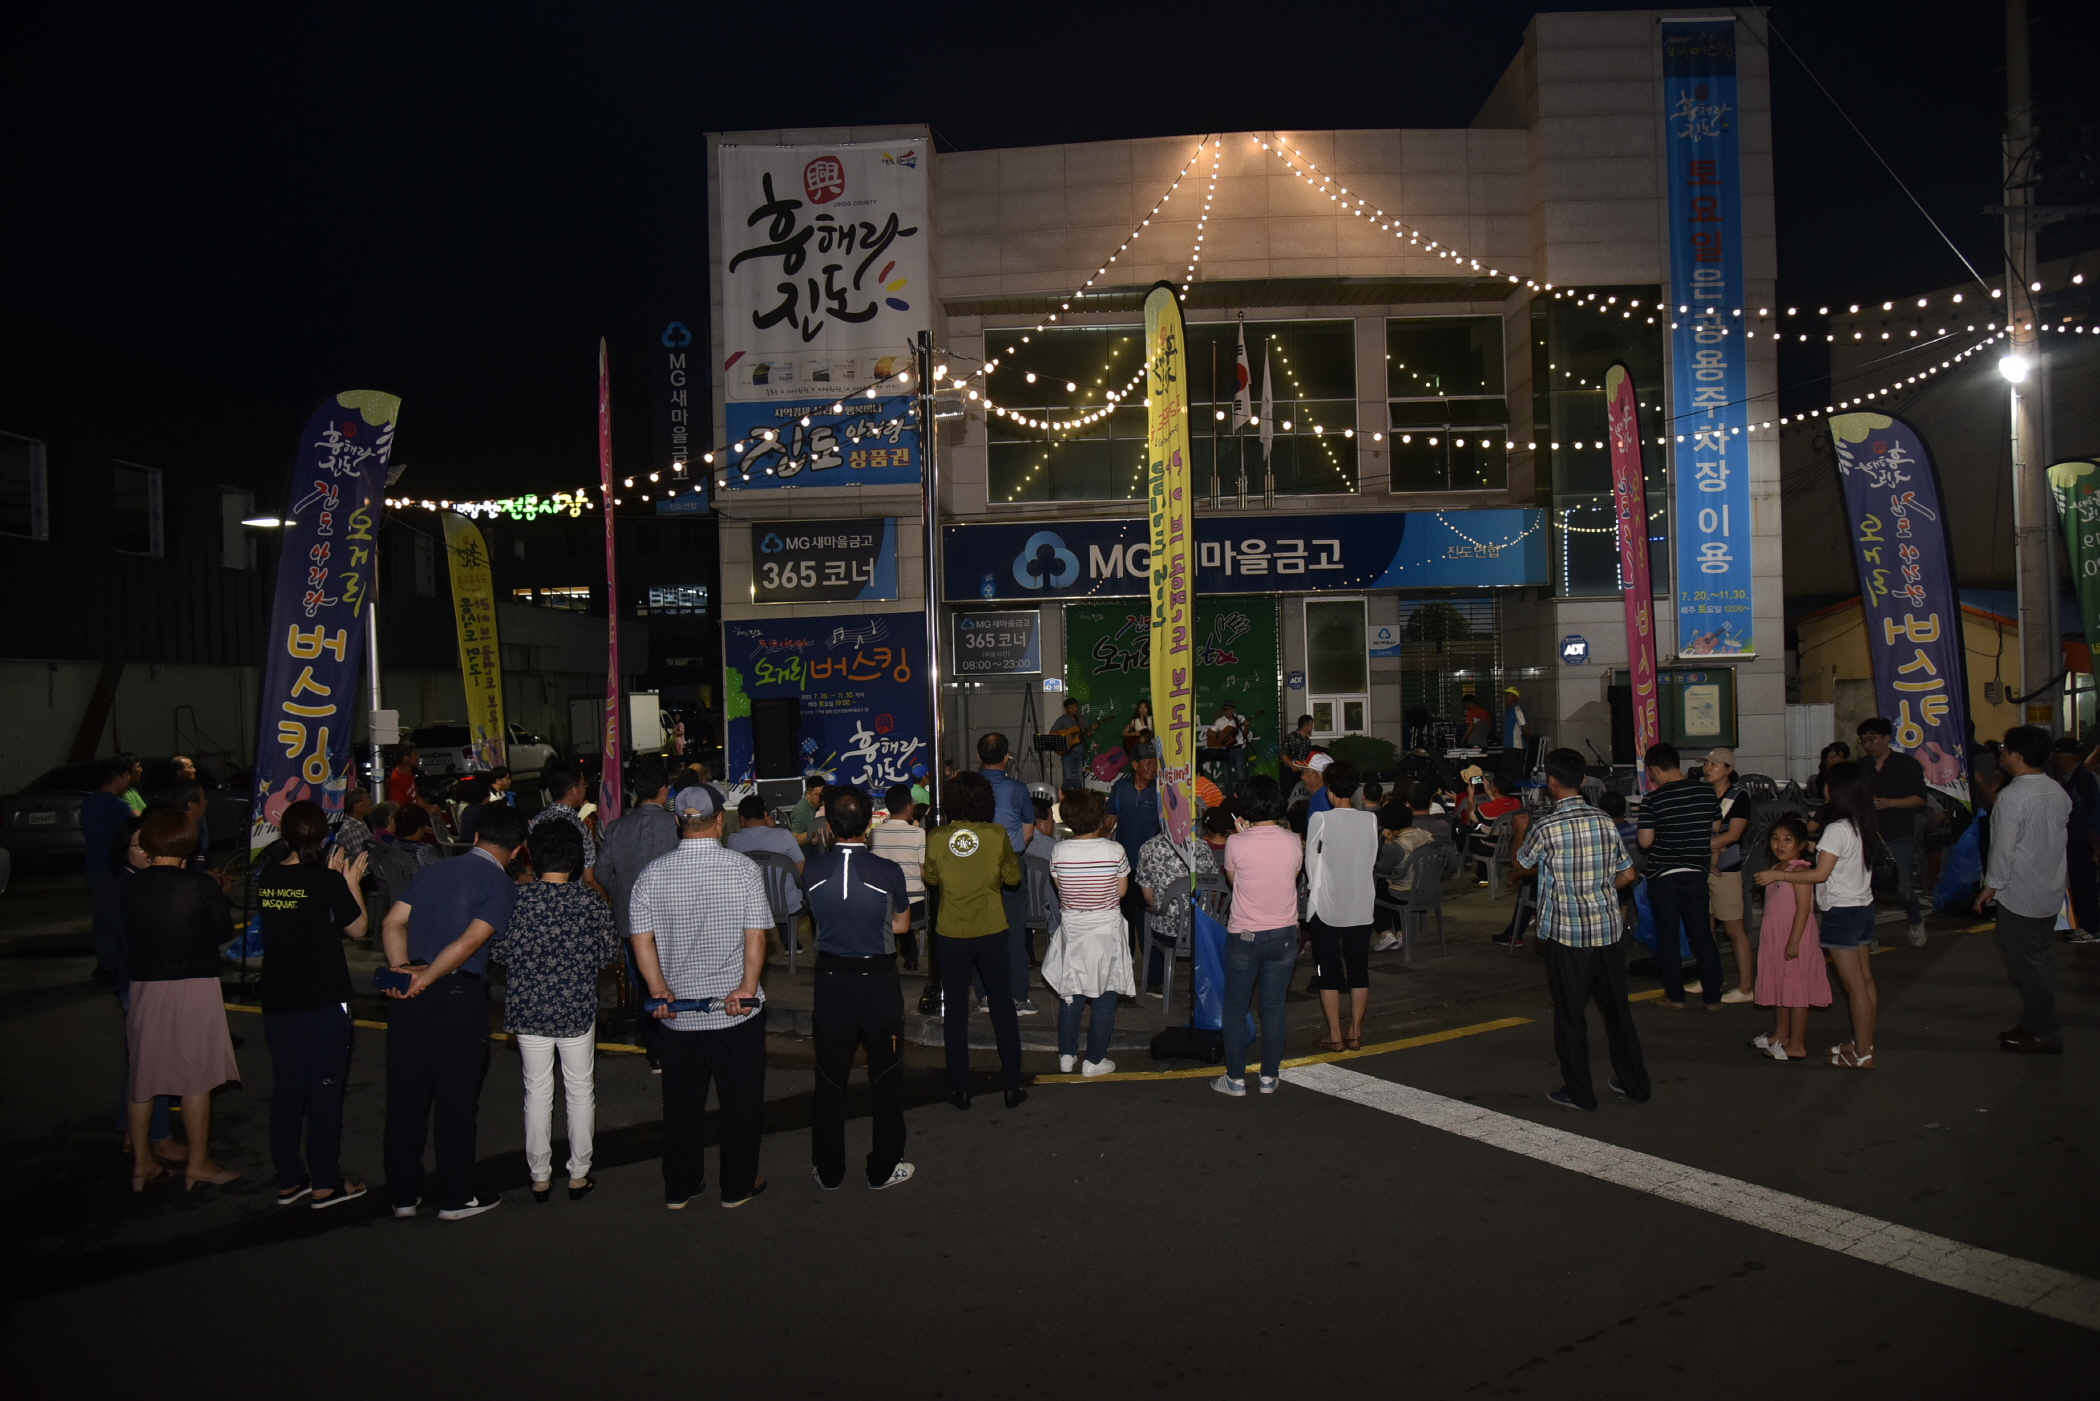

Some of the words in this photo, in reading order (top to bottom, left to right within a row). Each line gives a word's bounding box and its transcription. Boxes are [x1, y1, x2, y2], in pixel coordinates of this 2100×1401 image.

[1678, 119, 1720, 143] 진도
[833, 200, 852, 208] JINDO
[853, 199, 877, 207] COUNTY
[729, 172, 918, 291] 흥해라
[752, 264, 878, 342] 진도
[845, 403, 884, 416] 행복머니
[314, 420, 376, 467] 흥해라
[318, 455, 361, 478] 진도
[849, 449, 910, 468] 상품권
[1696, 504, 1733, 574] 이용
[1447, 544, 1500, 560] 진도연합
[762, 560, 817, 589] 365
[823, 557, 875, 587] 코너
[1698, 604, 1722, 614] 토요일
[965, 633, 995, 648] 365
[998, 631, 1027, 648] 코너
[1564, 643, 1586, 656] ADT
[810, 647, 911, 683] 버스킹
[1290, 676, 1303, 684] ADT
[278, 622, 348, 785] 버스킹
[840, 720, 926, 767] 흥해라
